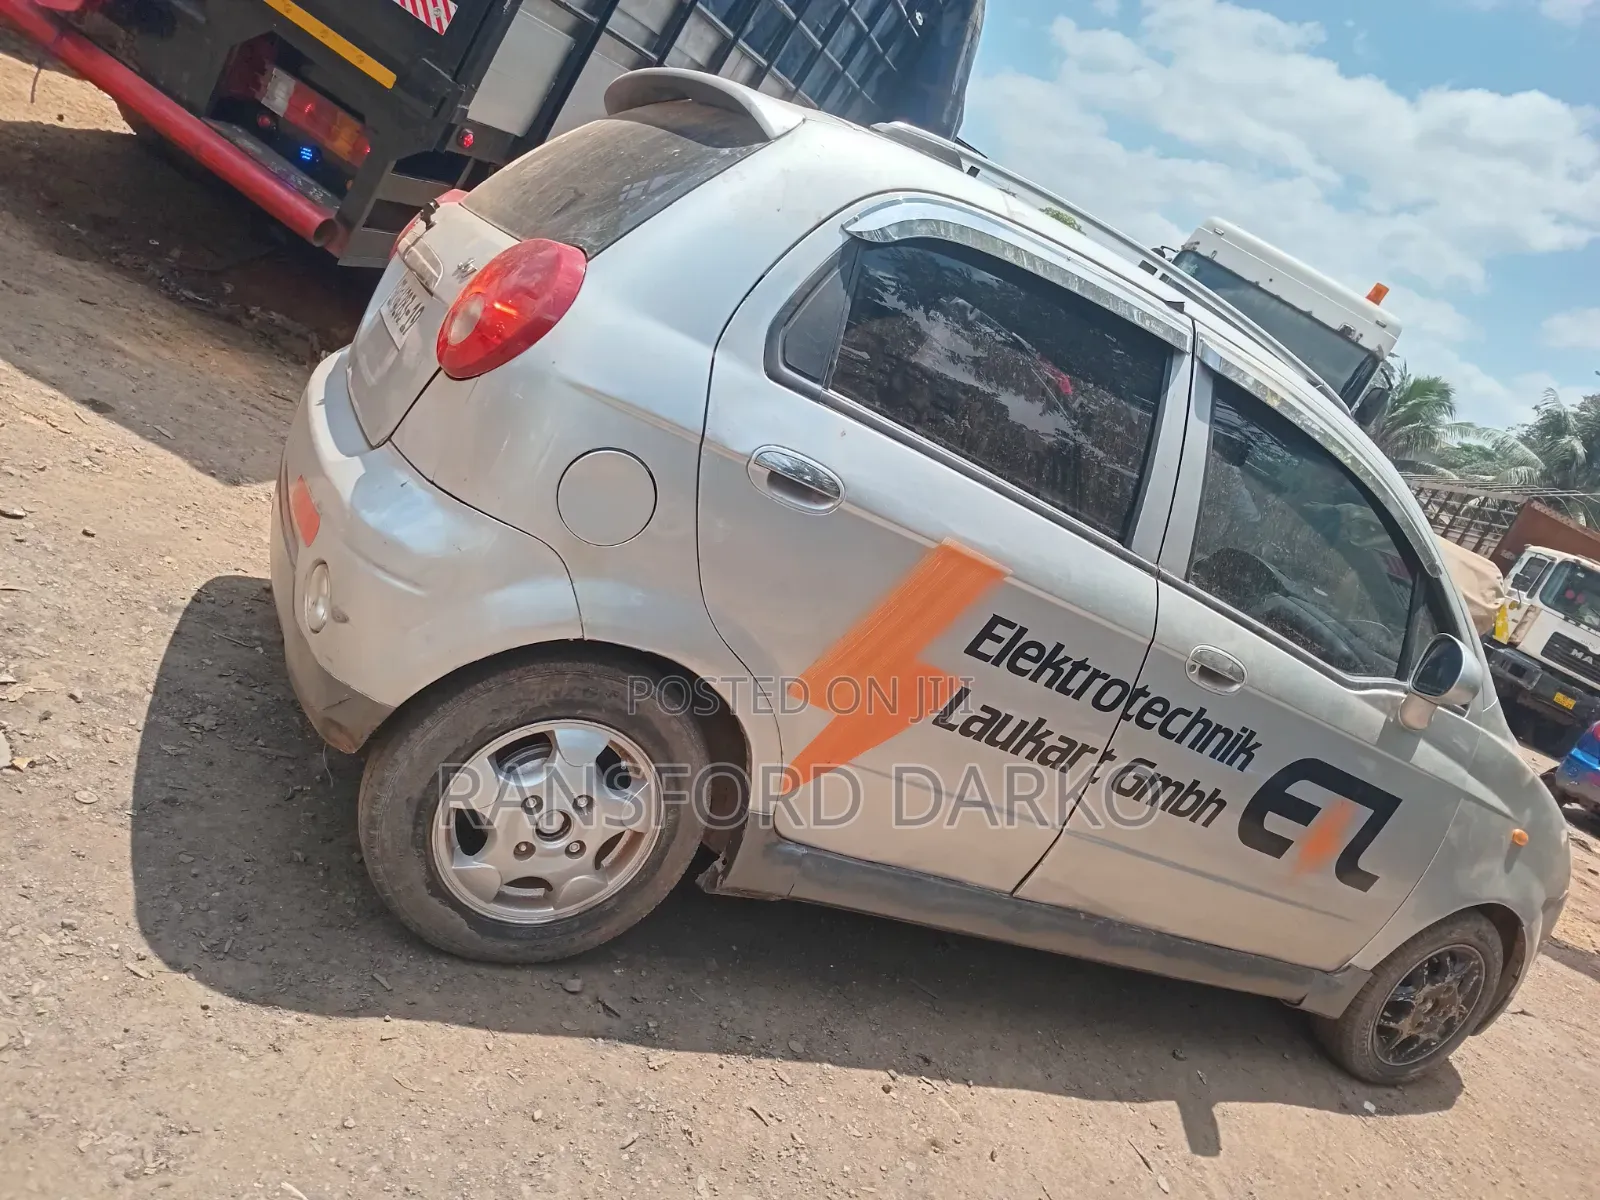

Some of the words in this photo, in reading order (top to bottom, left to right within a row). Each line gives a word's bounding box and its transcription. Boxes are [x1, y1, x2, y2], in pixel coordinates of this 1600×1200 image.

[931, 686, 1116, 784] Laukart
[1110, 757, 1227, 828] Gmbh
[964, 613, 1262, 773] Elektrotechnik
